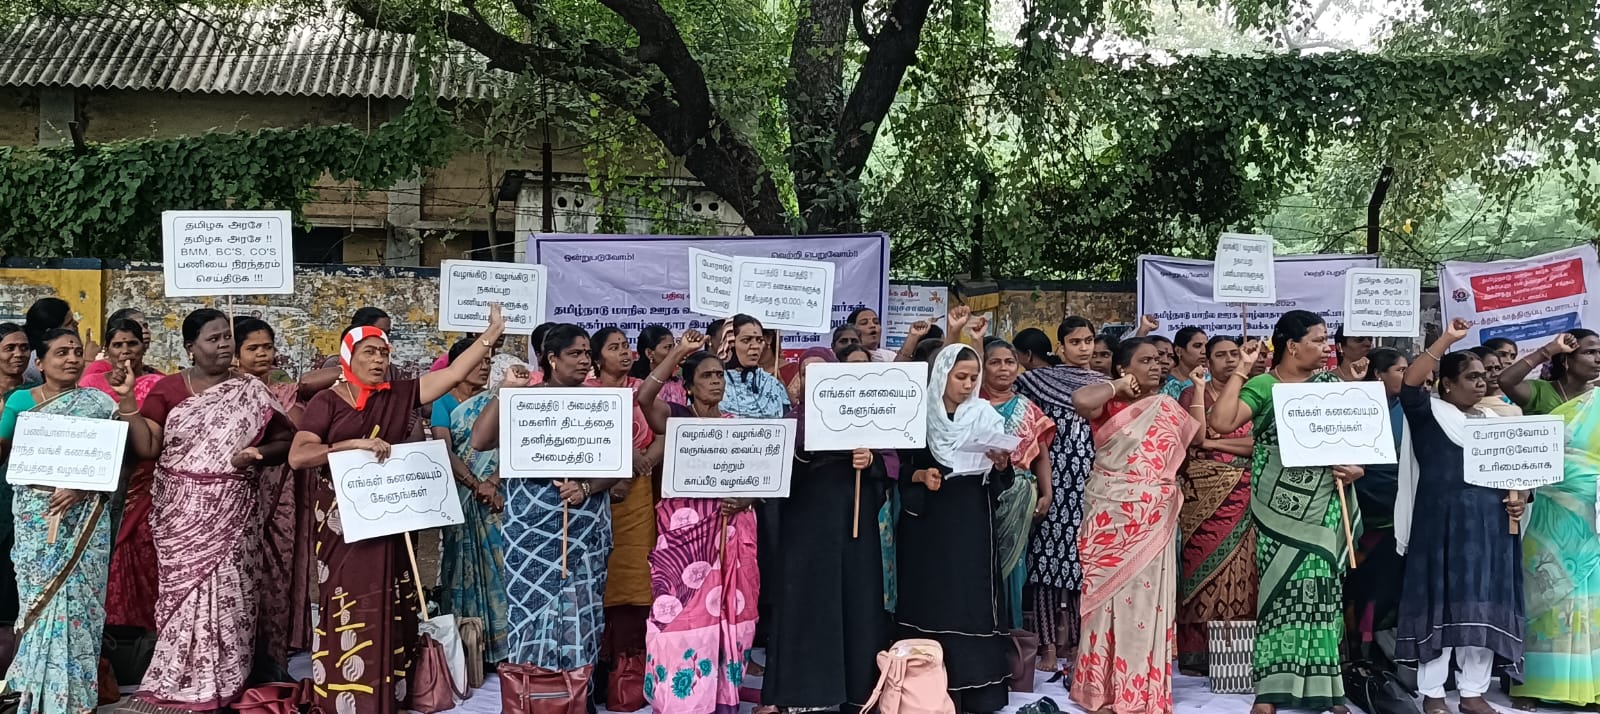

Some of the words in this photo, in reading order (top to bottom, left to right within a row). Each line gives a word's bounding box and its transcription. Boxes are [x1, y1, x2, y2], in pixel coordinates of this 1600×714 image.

[185, 221, 223, 231] தமிழக
[228, 221, 262, 230] அரசே
[184, 235, 222, 245] தமிழக
[227, 235, 261, 244] அரசே
[178, 260, 227, 269] பணியை
[232, 259, 280, 269] நிரந்தரம்
[196, 274, 250, 284] செய்திடுக
[453, 270, 487, 281] வழங்கிடு
[495, 272, 528, 283] வழங்கிடு
[554, 304, 609, 317] தமிழ்நாடு
[611, 304, 647, 316] மாநில
[650, 306, 680, 315] ஊரக
[779, 332, 821, 342] ளர்கள்
[819, 387, 856, 399] எங்கள்
[858, 386, 917, 400] கனவையும்
[517, 401, 559, 412] அமைத்திடு
[567, 401, 609, 412] அமைத்திடு
[839, 403, 896, 418] கேளுங்கள்
[1288, 406, 1321, 417] எங்கள்
[1325, 404, 1379, 417] கனவையும்
[518, 417, 558, 427] மகளிர்
[560, 417, 614, 430] திட்டத்தை
[1309, 420, 1363, 435] கேளுங்கள்
[682, 429, 723, 441] வழங்கிடு
[732, 428, 772, 441] வழங்கிடு
[1473, 426, 1549, 440] போராடுவோம்
[520, 434, 611, 447] தனித்துறையாக
[679, 445, 728, 456] வருங்கால
[731, 444, 762, 456] வைப்பு
[764, 444, 780, 456] நிதி
[1471, 443, 1549, 456] போராடுவோம்
[531, 451, 594, 464] அமைத்திடு
[57, 463, 95, 478] வழங்கிடு
[713, 460, 745, 473] மற்றும்
[1479, 460, 1552, 472] உரிமைக்காக
[347, 475, 382, 489] எங்கள்
[387, 467, 442, 485] கனவையும்
[684, 475, 717, 487] காப்பீடு
[720, 475, 760, 488] வழங்கிடு
[370, 486, 427, 504] கேளுங்கள்
